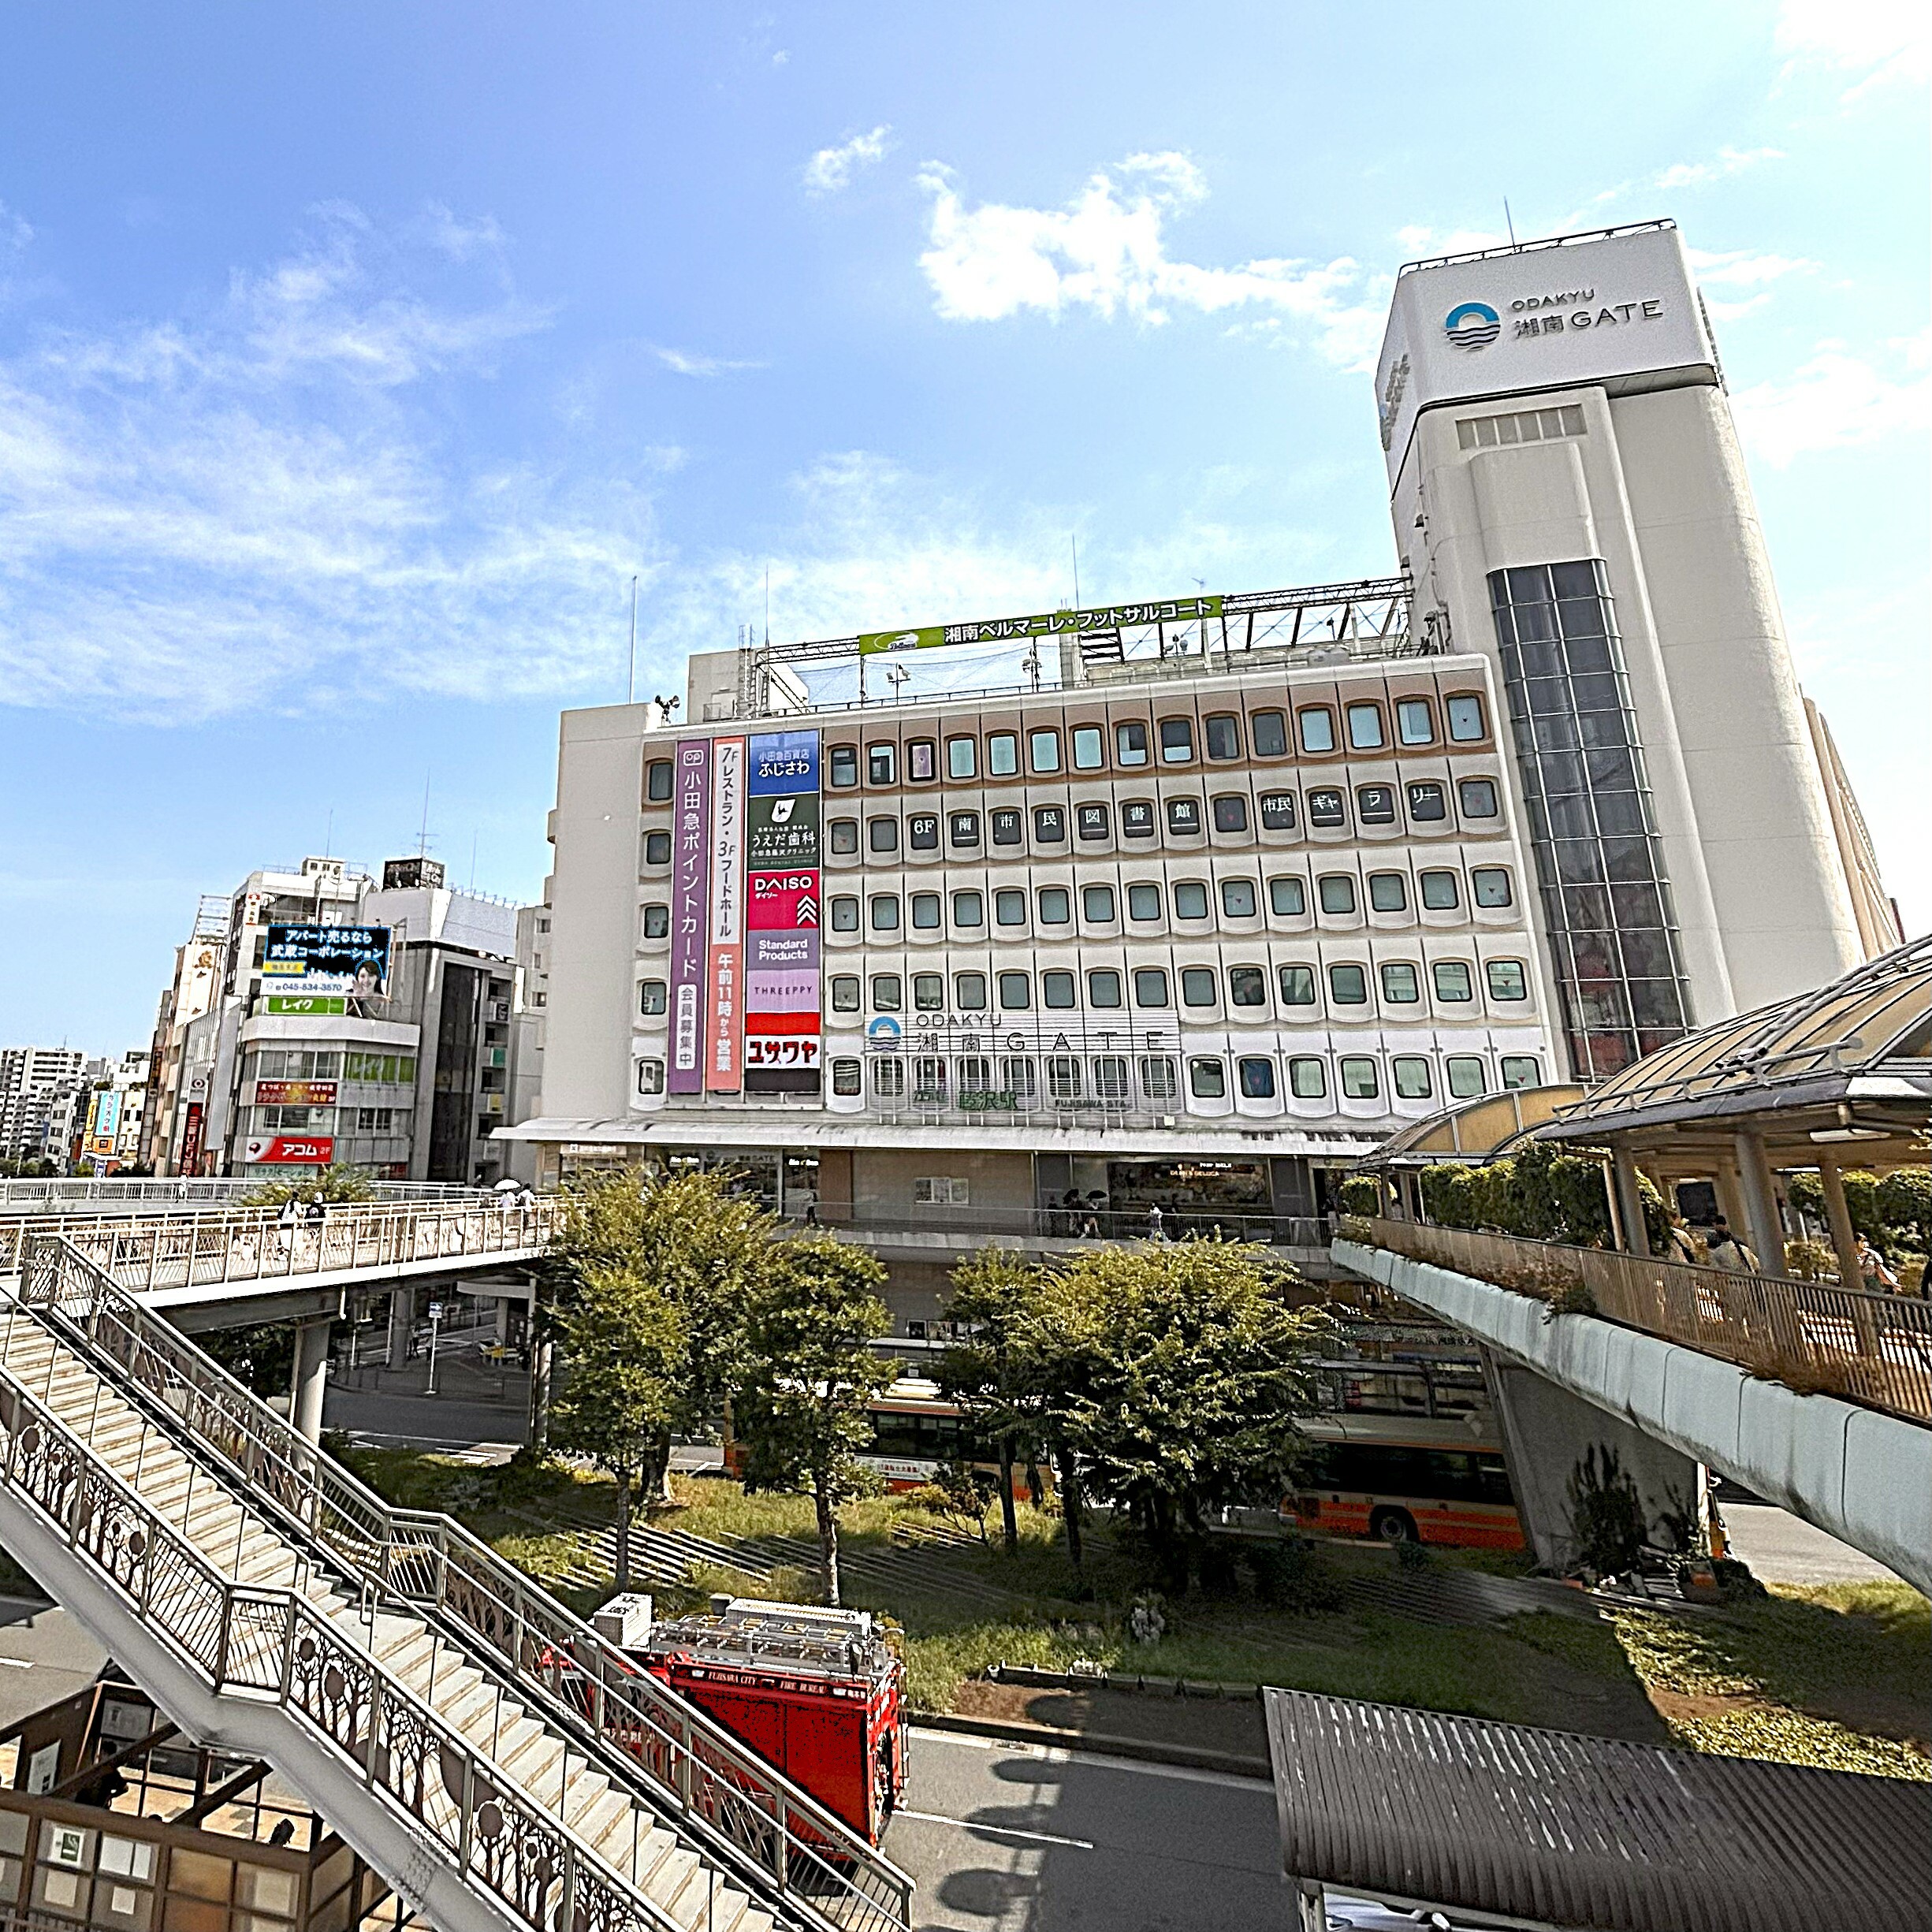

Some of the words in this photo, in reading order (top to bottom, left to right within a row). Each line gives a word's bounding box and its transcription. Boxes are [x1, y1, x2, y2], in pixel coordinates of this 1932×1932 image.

[1511, 288, 1595, 313] ODAKYU
[945, 599, 1212, 643] 湘南ベルマーレ・フットサルコート
[759, 760, 810, 777] ふじさわ
[914, 820, 935, 834] 6F
[753, 831, 816, 847] うえだ歯科
[681, 770, 702, 977] 小田急ポイントカード
[754, 876, 813, 891] DAISO
[285, 929, 374, 944] アパート売るなら
[270, 944, 385, 959] 武蔵コーポレーション
[759, 939, 808, 950] Standard
[759, 950, 808, 960] Products
[754, 986, 812, 995] THREEPPY
[281, 999, 314, 1010] レイク
[717, 953, 733, 1071] 午前11時から営業
[679, 987, 694, 1066] 会員募集中
[916, 1014, 1003, 1027] ODAKYU
[282, 1144, 317, 1156] アコム
[740, 1675, 756, 1685] CITY
[780, 1680, 796, 1690] FIRE
